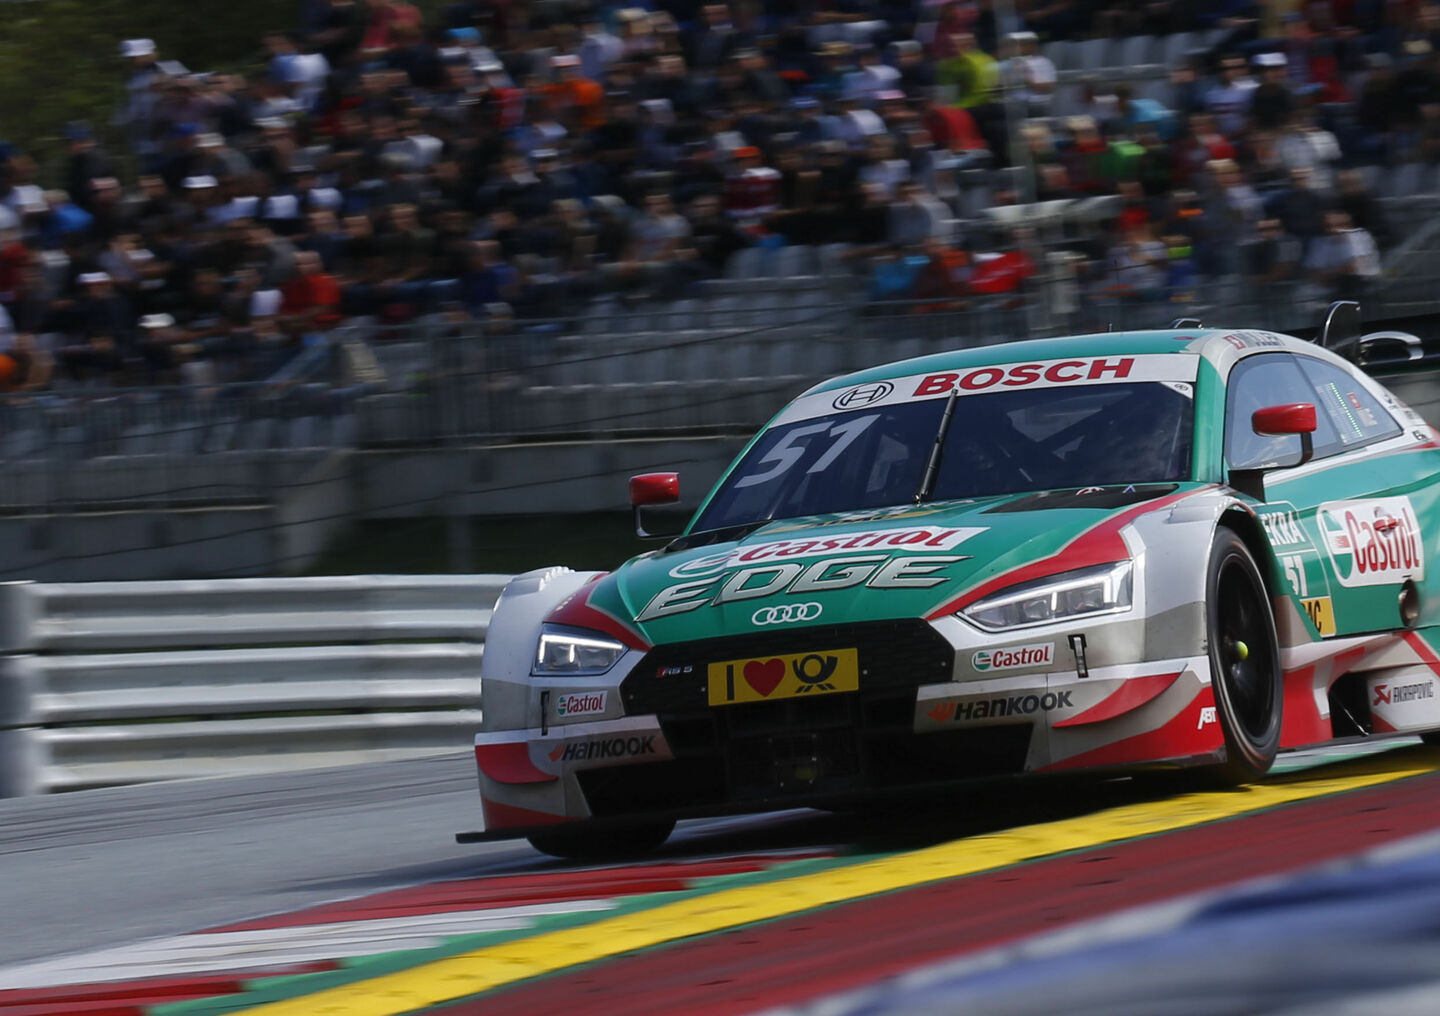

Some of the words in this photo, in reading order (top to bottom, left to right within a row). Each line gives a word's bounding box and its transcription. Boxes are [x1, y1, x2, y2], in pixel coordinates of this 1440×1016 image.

[912, 359, 1135, 397] BOSCH
[734, 414, 881, 488] 51
[739, 527, 957, 563] Castrol
[1261, 510, 1305, 547] EKRA
[634, 554, 974, 622] EDGE
[1283, 555, 1308, 597] 51
[992, 646, 1049, 668] Castrol
[726, 664, 735, 701] I
[566, 693, 605, 714] Castrol
[1197, 706, 1217, 730] ABT
